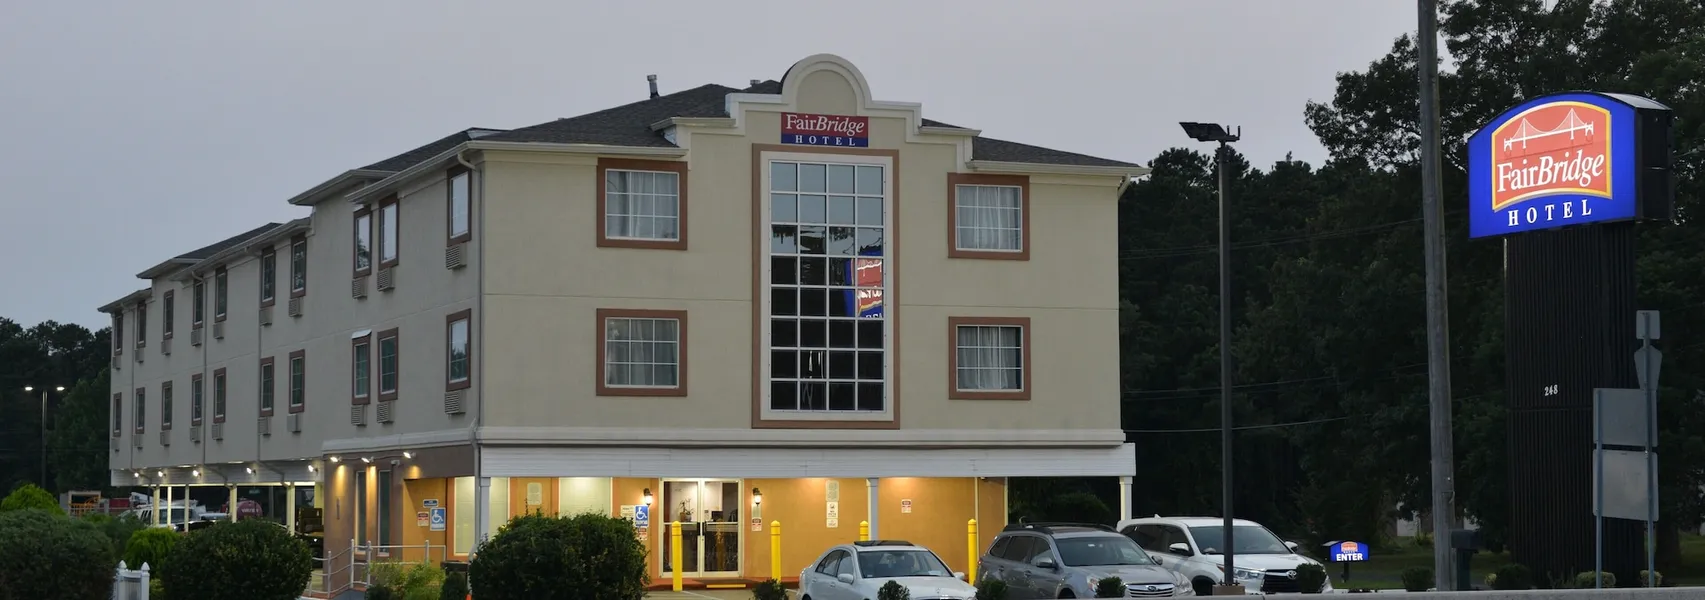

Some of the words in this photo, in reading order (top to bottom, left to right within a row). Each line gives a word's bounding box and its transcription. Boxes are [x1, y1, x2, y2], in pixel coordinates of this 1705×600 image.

[786, 114, 864, 136] FairBridge
[795, 135, 855, 146] HOTEL
[1496, 149, 1605, 192] FairBridge
[1507, 199, 1592, 227] HOTEL
[1544, 384, 1558, 396] 248
[1336, 553, 1363, 561] ENTER
